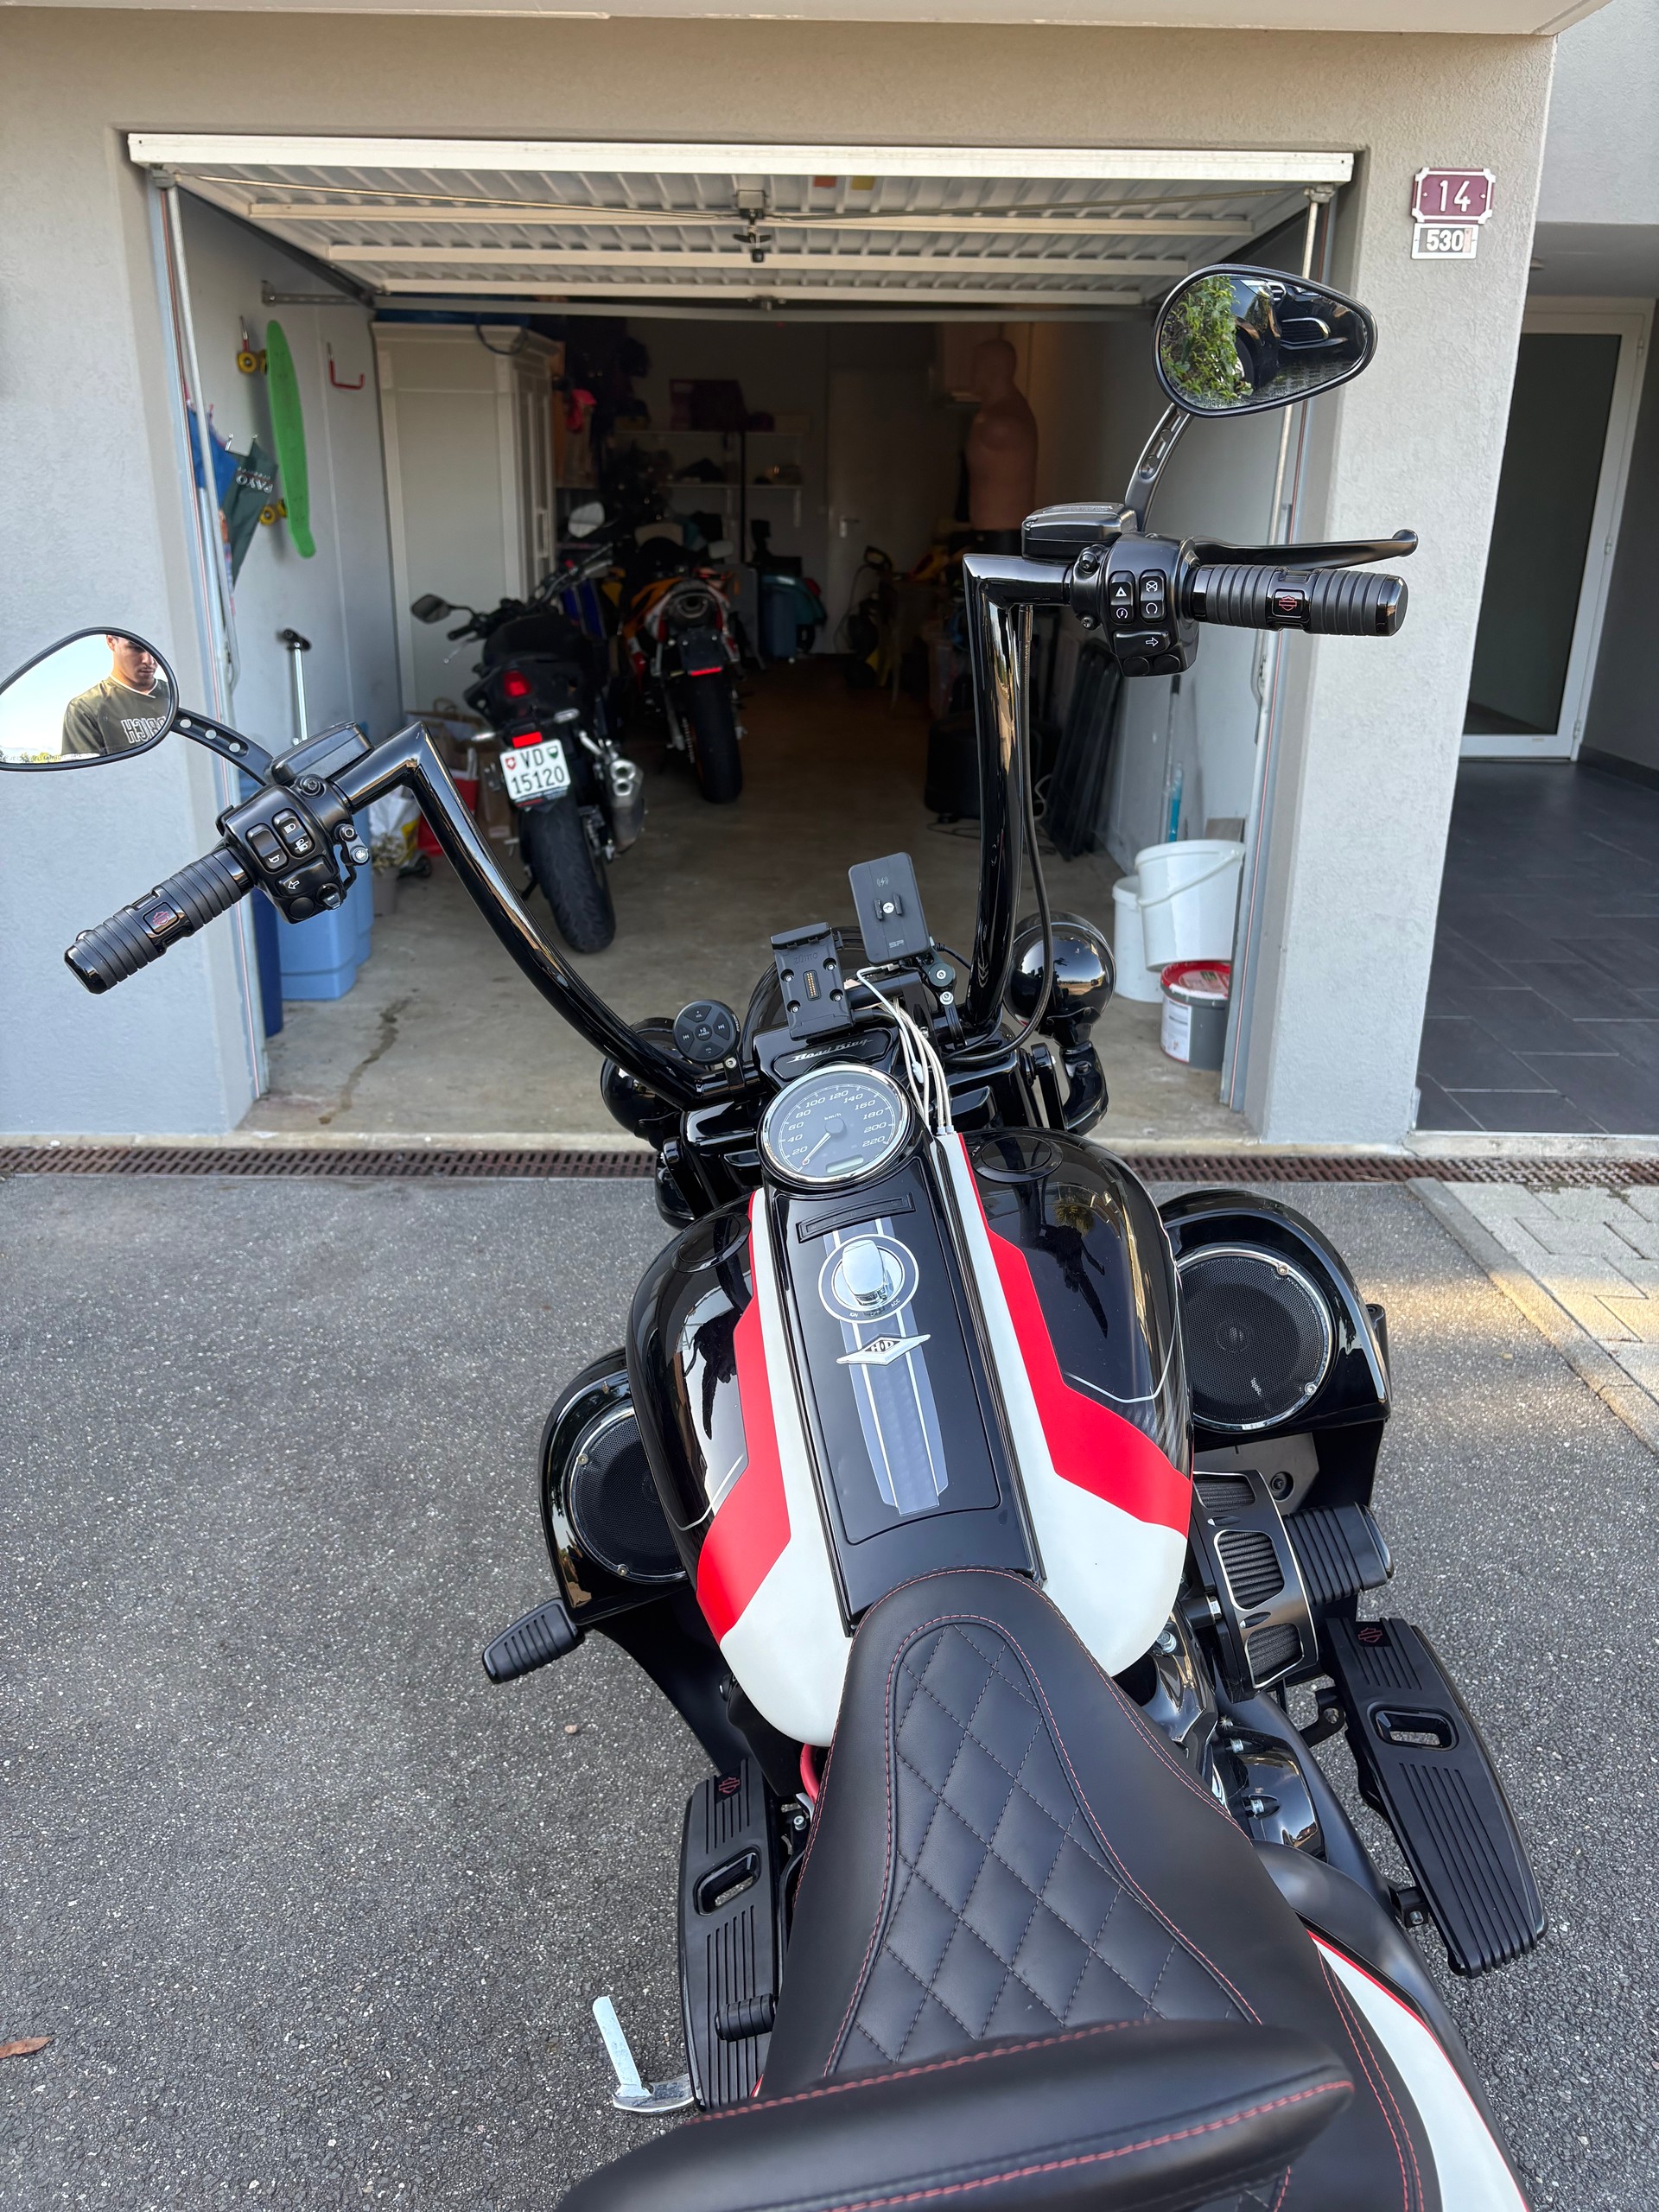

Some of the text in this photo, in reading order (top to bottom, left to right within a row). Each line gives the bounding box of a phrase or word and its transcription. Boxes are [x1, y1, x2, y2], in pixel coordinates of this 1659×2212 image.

[1439, 180, 1471, 213] 14
[1426, 229, 1465, 252] 530
[520, 748, 544, 768] VD
[511, 766, 565, 794] 15120
[830, 1090, 849, 1099] 120
[843, 1093, 863, 1103] 140
[805, 1097, 825, 1108] 100
[855, 1100, 875, 1110] 160
[796, 1109, 811, 1118] 80
[863, 1109, 884, 1120] 180
[788, 1122, 804, 1131] 60
[864, 1122, 887, 1133] 200
[862, 1136, 885, 1147] 220
[792, 1146, 808, 1155] 20
[891, 1299, 900, 1307] ACC
